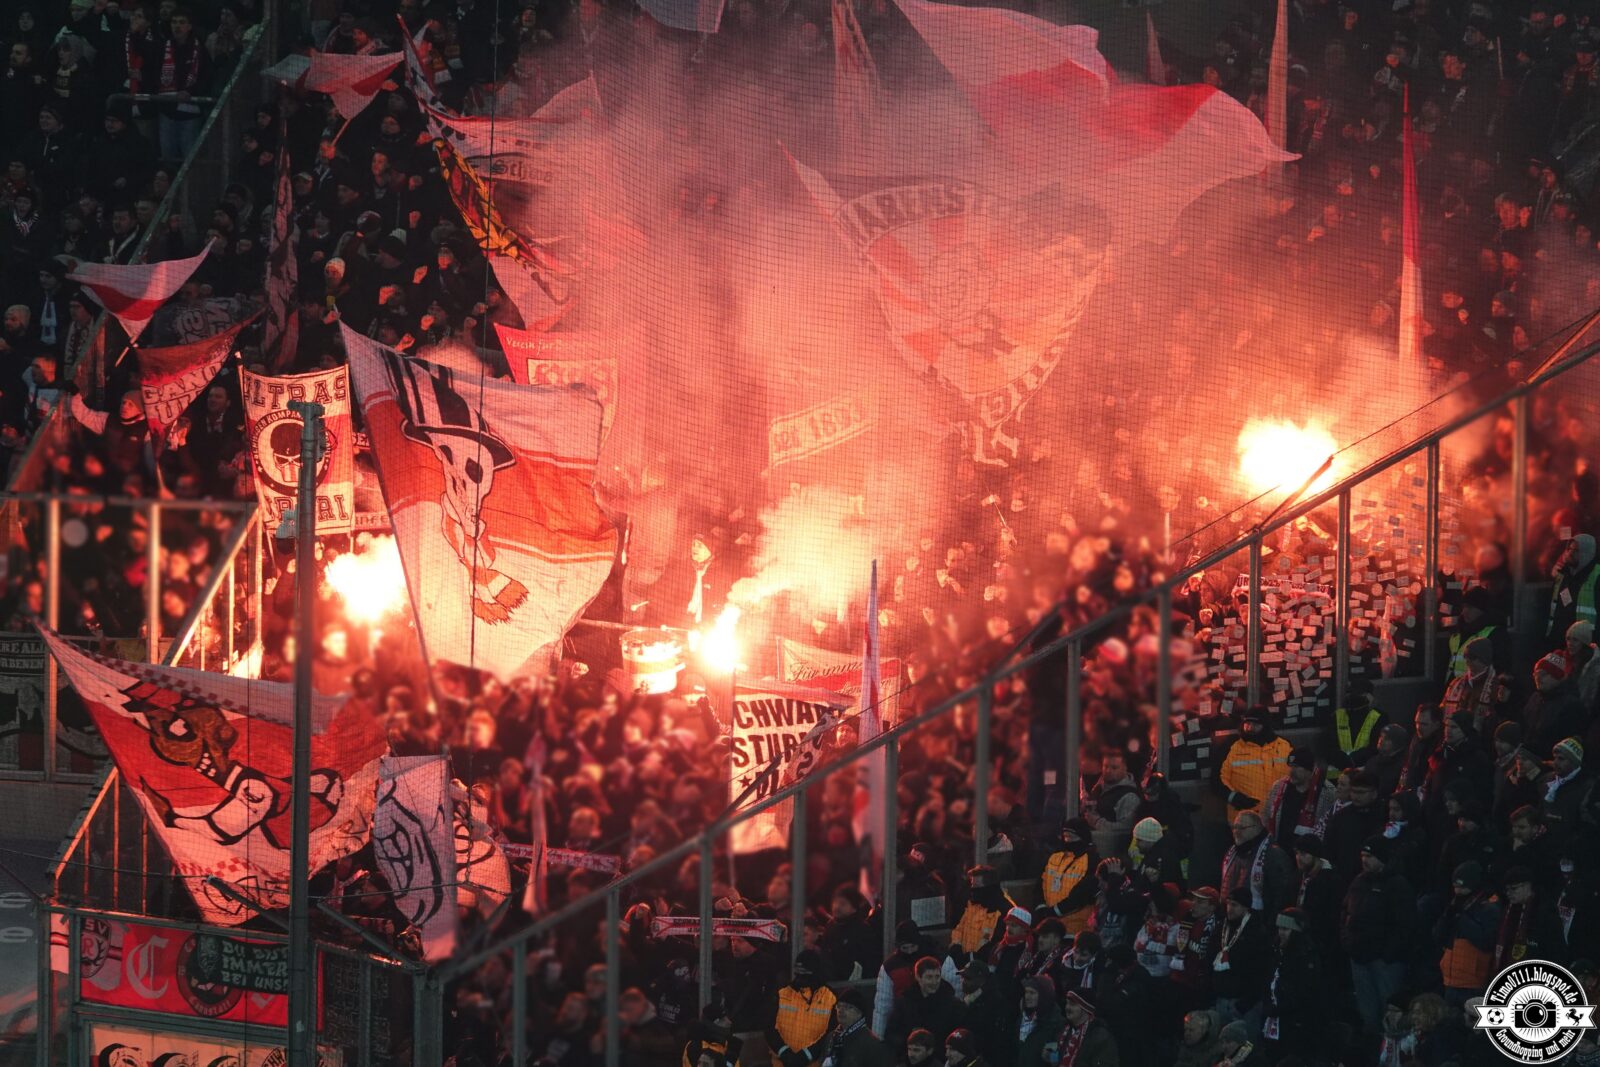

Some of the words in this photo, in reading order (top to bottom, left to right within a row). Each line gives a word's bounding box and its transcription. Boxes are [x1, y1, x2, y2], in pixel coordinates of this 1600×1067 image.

[731, 733, 806, 768] STUR
[222, 940, 246, 957] DU
[222, 955, 289, 977] IMMER
